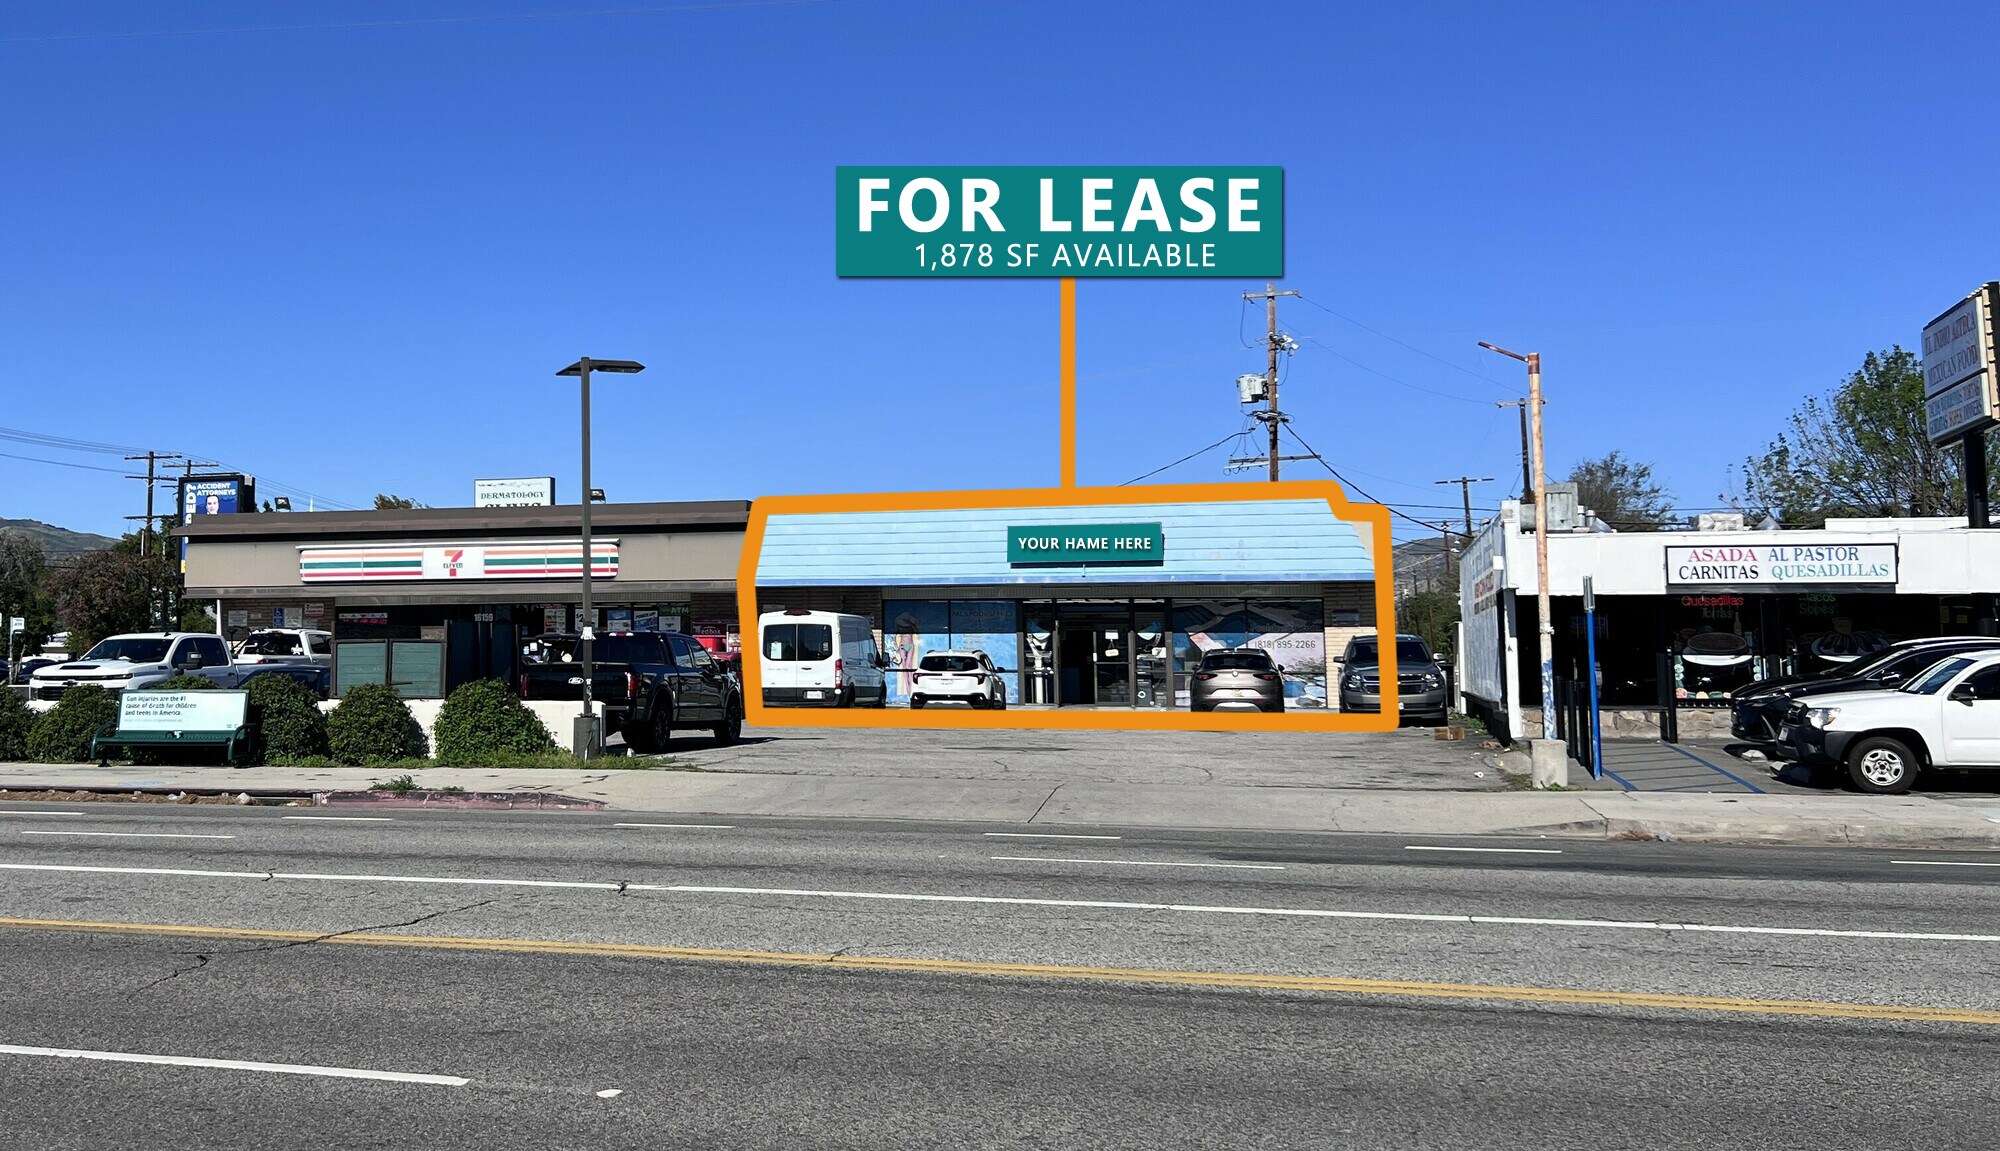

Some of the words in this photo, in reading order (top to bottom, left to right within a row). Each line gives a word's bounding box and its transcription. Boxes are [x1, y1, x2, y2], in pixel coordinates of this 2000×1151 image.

[1927, 355, 1957, 387] MEXICAN
[1957, 344, 1978, 373] FOOD
[481, 491, 545, 500] DERMATOLOGY
[1688, 549, 1758, 562] ASADA
[1768, 548, 1788, 562] AL
[1794, 547, 1859, 562] PASTOR
[444, 549, 463, 577] 7
[1679, 565, 1759, 580] CARNITAS
[1771, 564, 1889, 581] QUESADILLAS
[1681, 594, 1745, 606] Quesadillas
[671, 606, 690, 614] ATM
[474, 613, 494, 622] 16159
[1276, 640, 1292, 649] 895
[1295, 640, 1316, 649] 2266
